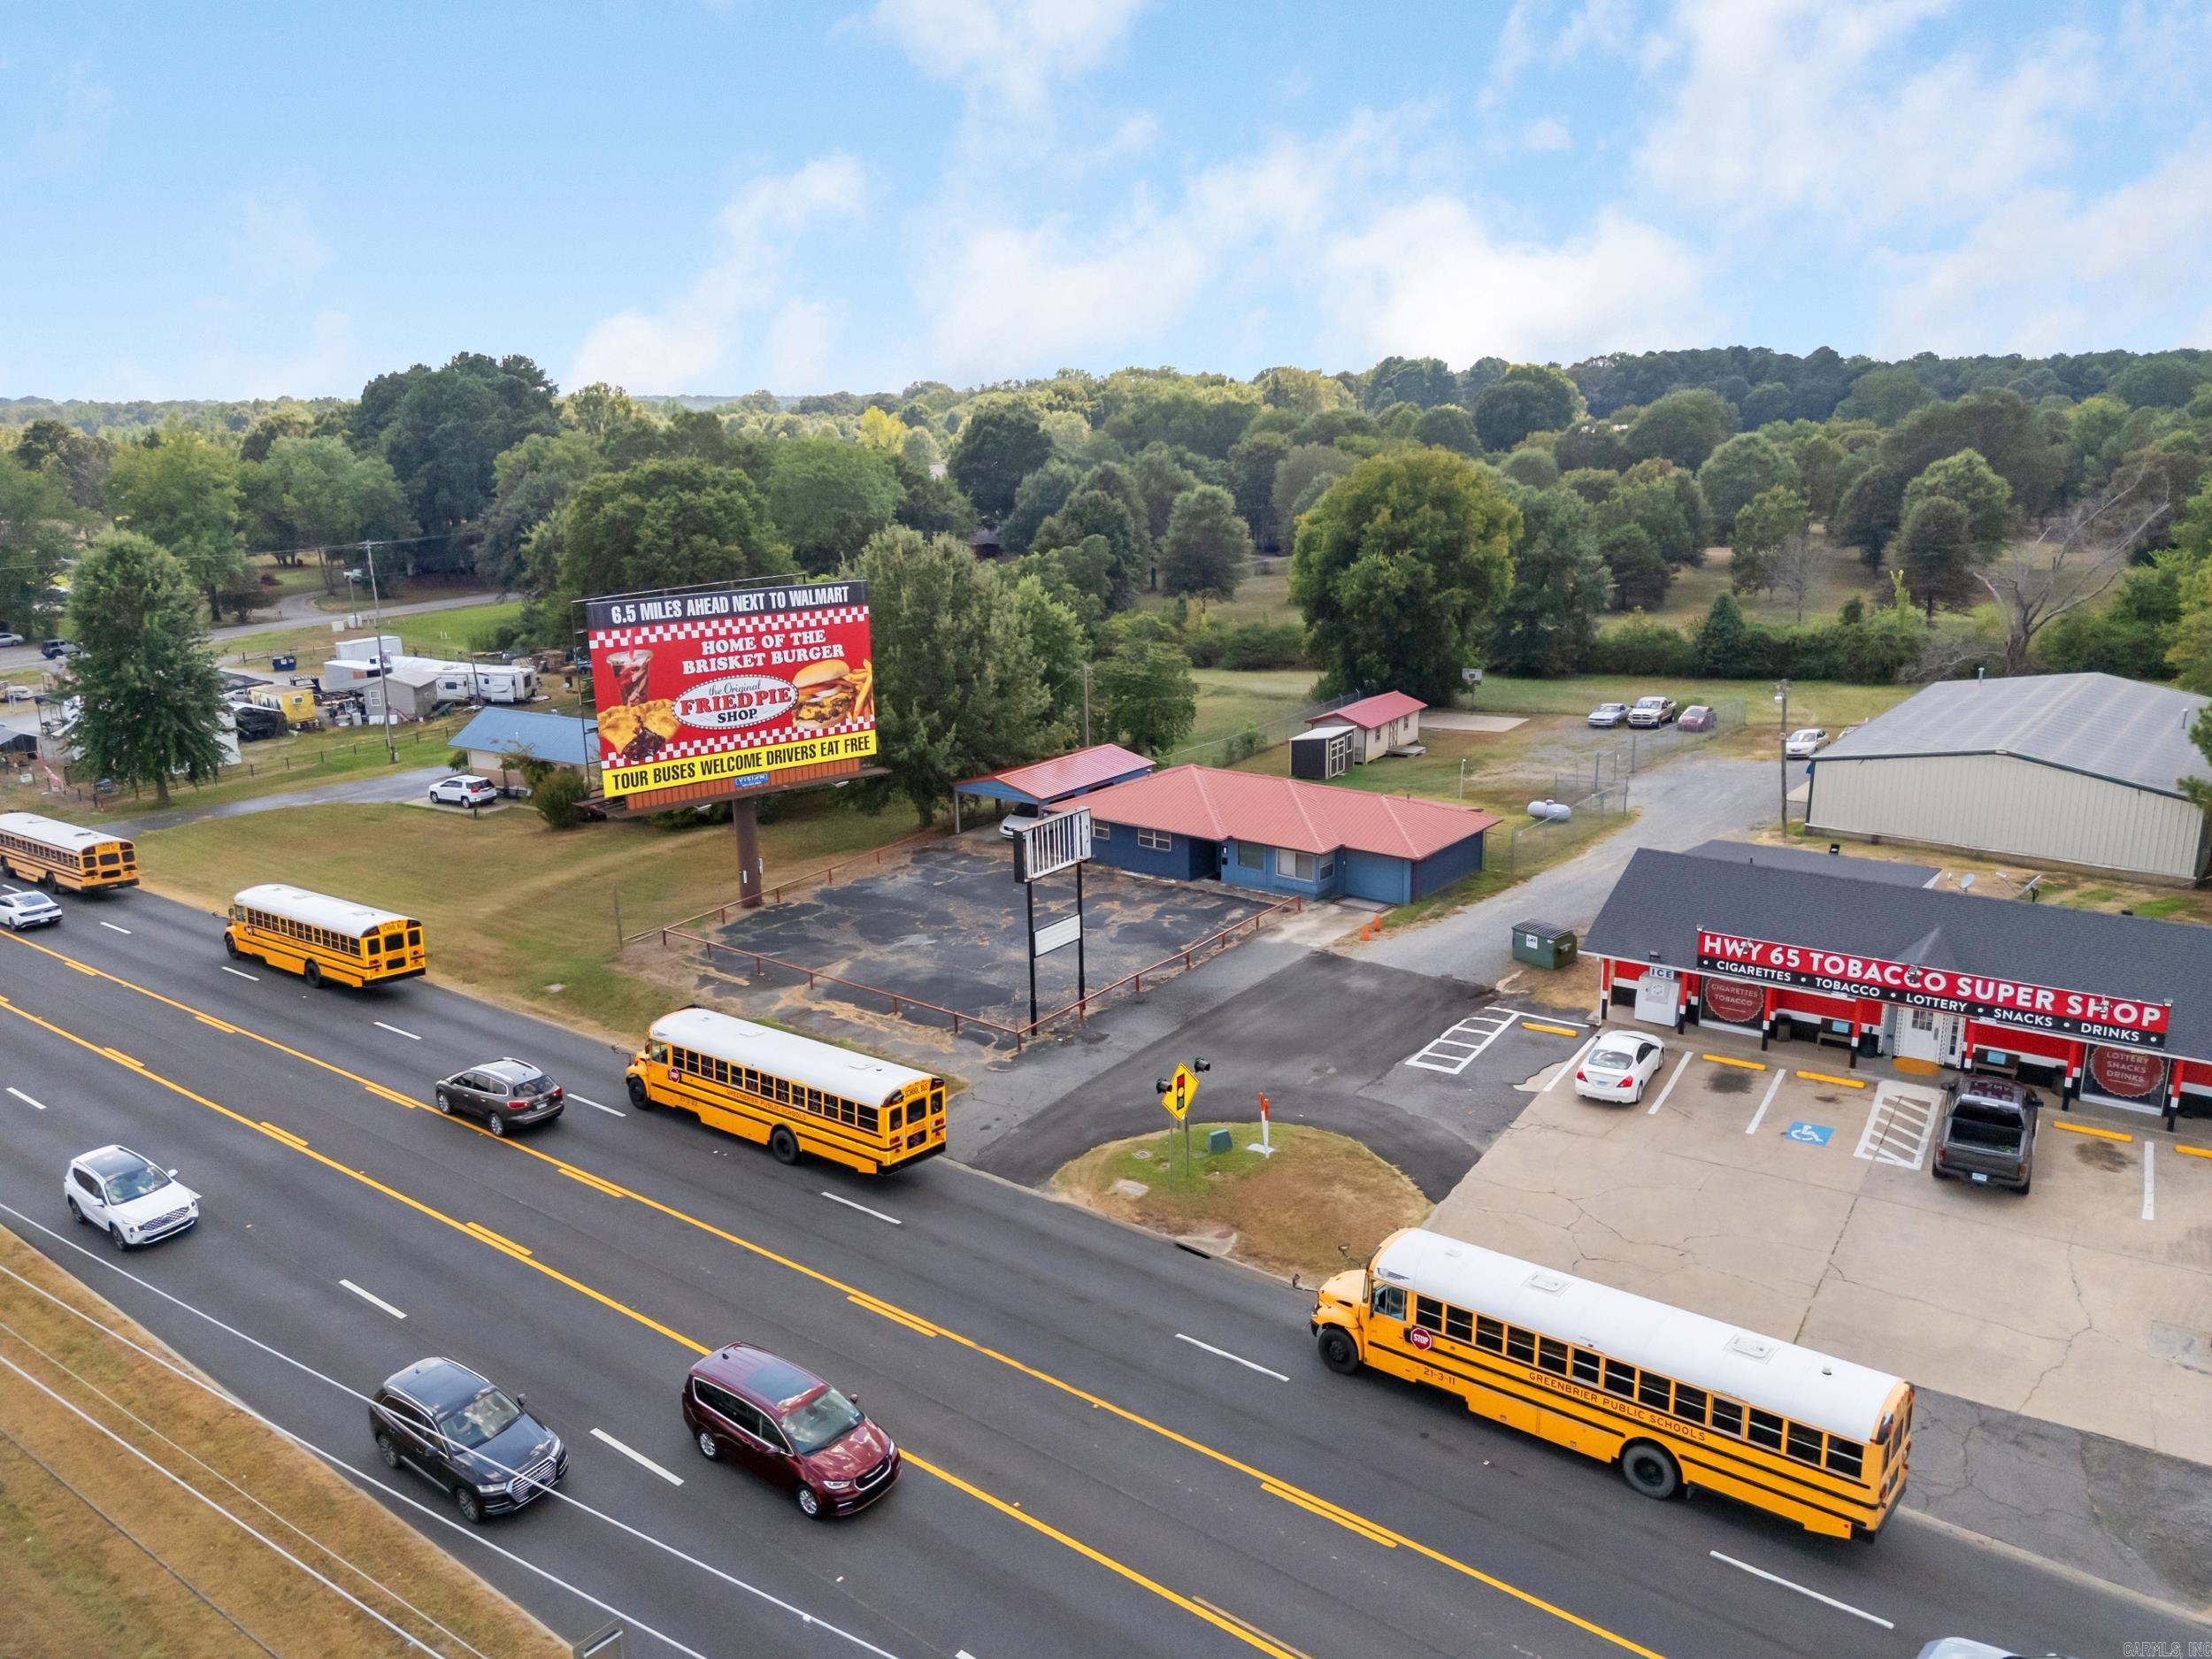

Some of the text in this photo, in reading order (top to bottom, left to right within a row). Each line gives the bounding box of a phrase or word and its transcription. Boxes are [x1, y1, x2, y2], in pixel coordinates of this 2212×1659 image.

[611, 586, 849, 624] 6.5 MILES AHEAD NEXT TO WALMART
[702, 629, 826, 656] HOME OF THE
[682, 644, 845, 674] BRISKET BURGER
[709, 680, 761, 696] the Original
[680, 687, 792, 716] FRIED PIE
[718, 708, 758, 723] SHOP
[612, 735, 870, 790] TOUR BUSES WELCOME DRIVERS EAT FREE
[1652, 968, 1672, 979] ICE
[1704, 935, 2161, 1027] HWY 65 TOBACCO SUPER SHOP
[1711, 983, 1758, 998] CIGARETTES
[1715, 994, 1753, 1006] TOBACCO
[1717, 960, 2139, 1041] CIGARETTES TOBACCO LOTTERY SNACKS DRINKS
[2107, 1051, 2149, 1064] LOTTERY
[2107, 1061, 2147, 1073] SNACKS
[2106, 1070, 2146, 1083] DRINKS
[904, 1086, 919, 1098] SCHOOL
[1413, 1333, 1429, 1345] STOP
[1424, 1367, 1455, 1385] 21-3-11
[1529, 1371, 1706, 1441] GREENBRIER PUBLIC SCHOOLS
